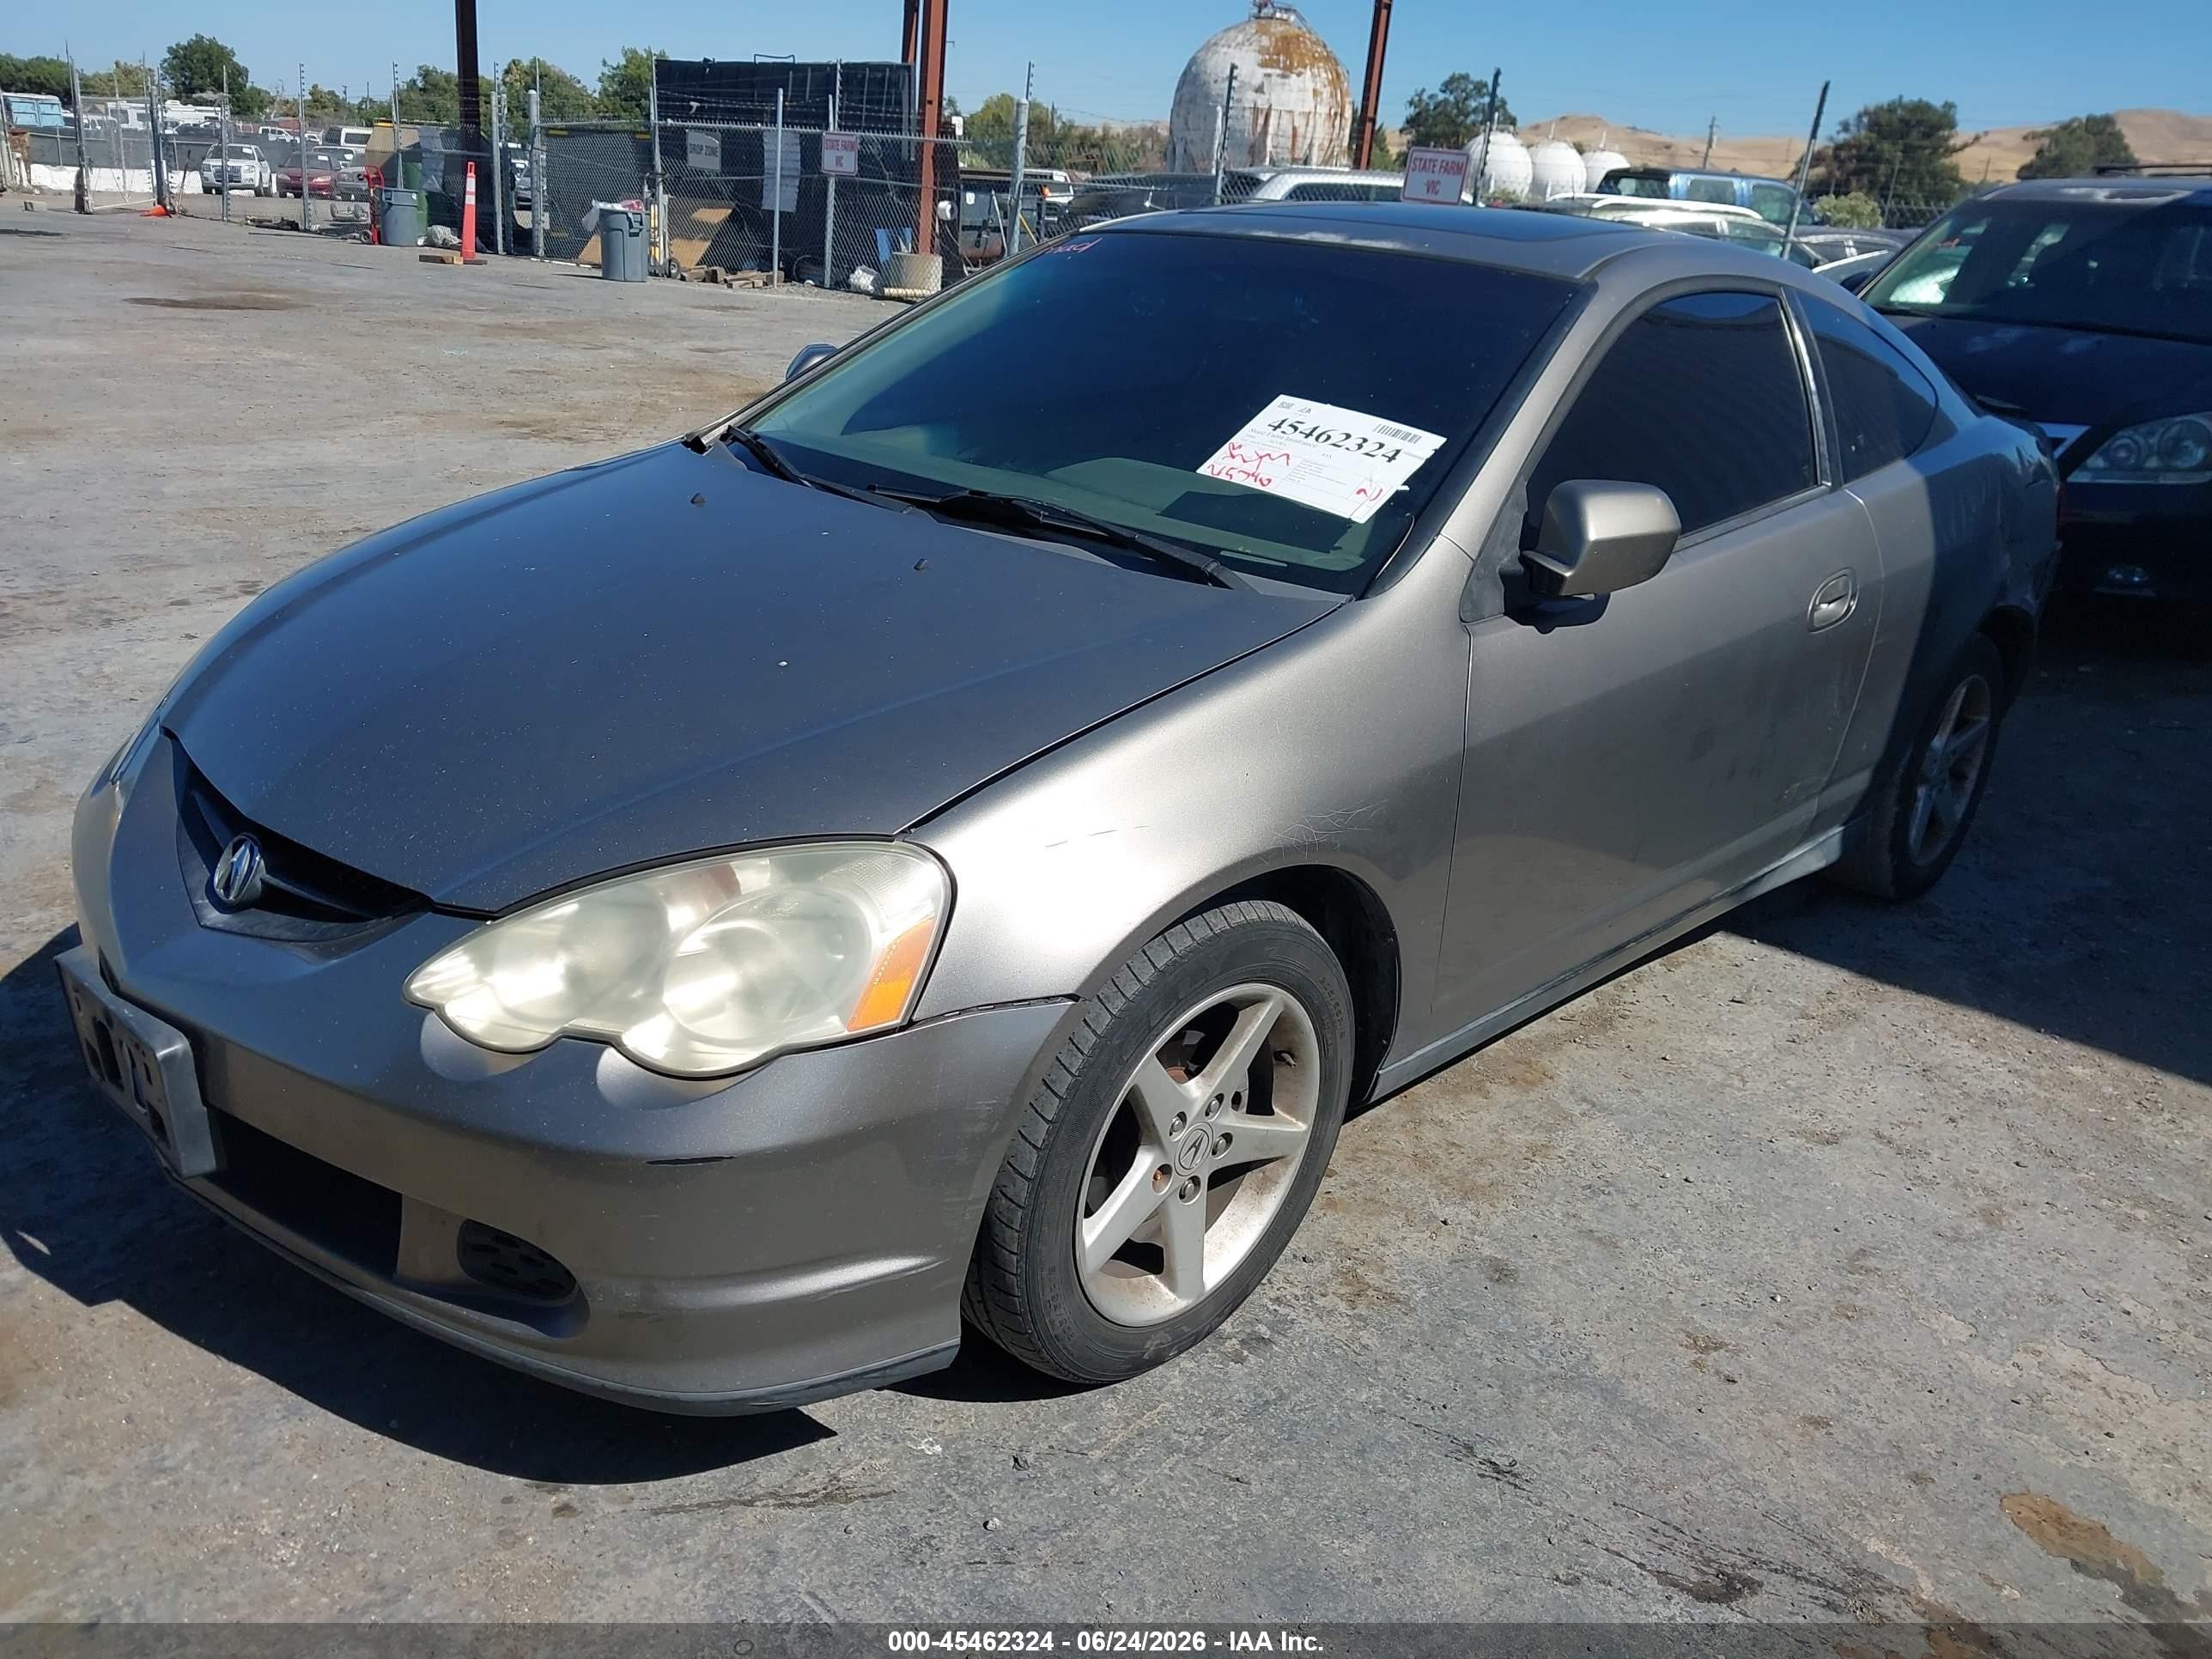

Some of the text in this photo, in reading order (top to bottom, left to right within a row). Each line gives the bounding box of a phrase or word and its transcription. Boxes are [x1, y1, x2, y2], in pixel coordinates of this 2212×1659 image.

[689, 143, 719, 157] DROP ZONE
[824, 138, 857, 151] STATE FARM
[1412, 157, 1464, 175] STATE FARM
[1267, 417, 1403, 464] 45462324
